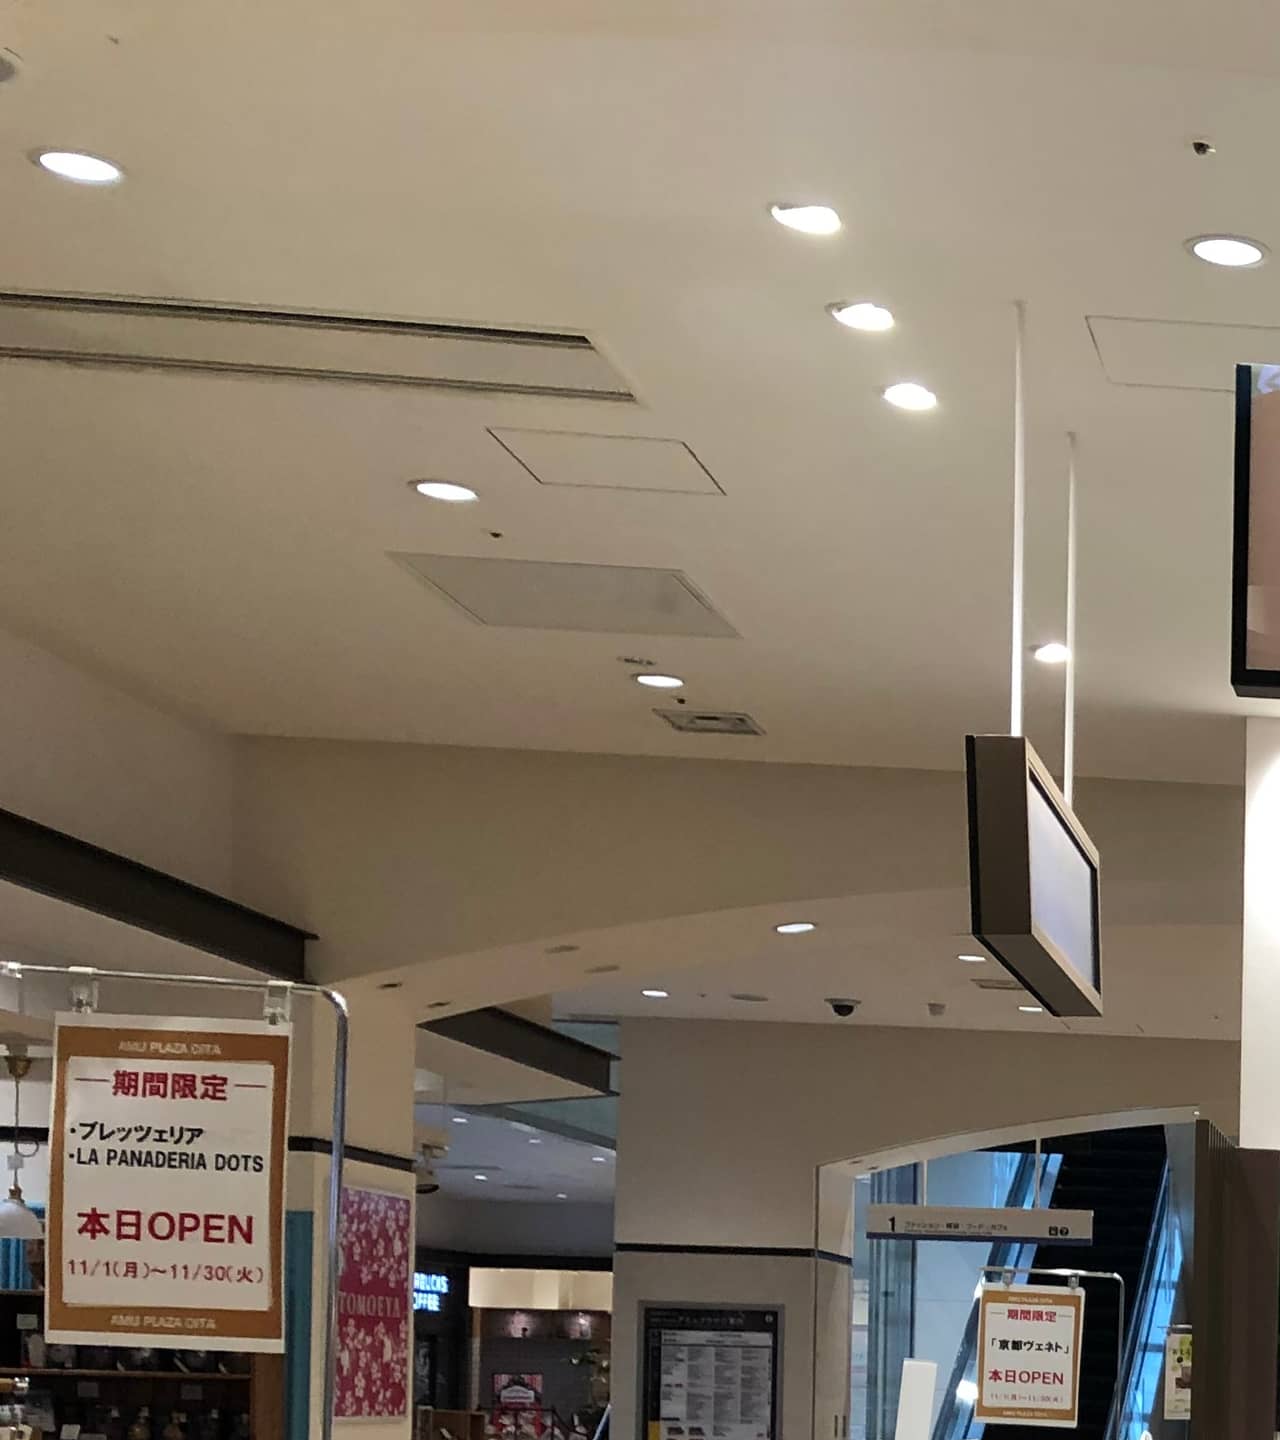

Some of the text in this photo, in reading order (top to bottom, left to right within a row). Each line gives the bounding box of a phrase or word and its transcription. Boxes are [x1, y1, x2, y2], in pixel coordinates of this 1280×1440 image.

[112, 1069, 229, 1101] 期間限定
[106, 1150, 207, 1170] PANADERIA
[214, 1153, 264, 1173] DOTS
[77, 1207, 254, 1244] 本日OPEN
[888, 1216, 896, 1232] 1
[1008, 1308, 1057, 1323] 期間限定
[988, 1369, 1064, 1385] 本日OPEN
